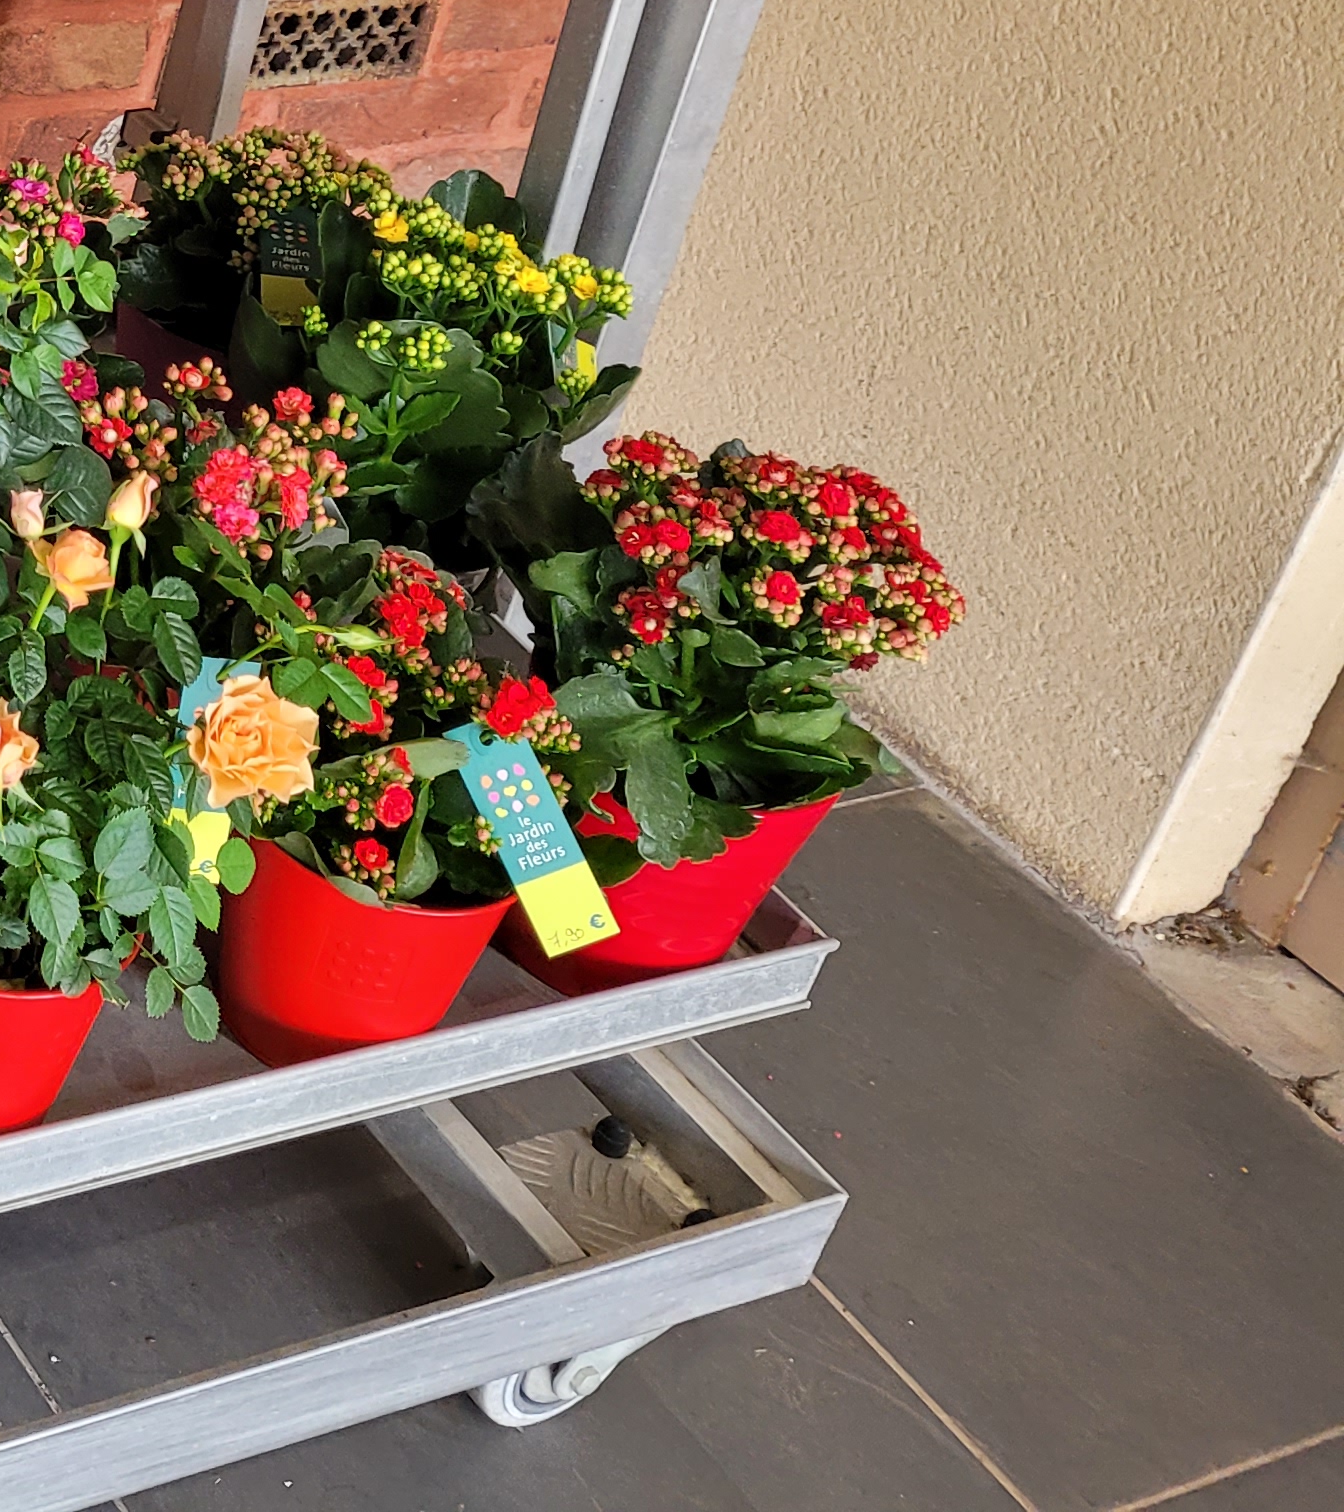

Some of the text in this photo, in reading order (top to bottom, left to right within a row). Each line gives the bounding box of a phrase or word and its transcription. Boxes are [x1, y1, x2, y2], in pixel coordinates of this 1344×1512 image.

[271, 247, 311, 258] Jardin
[271, 260, 311, 272] Fleurs
[517, 816, 531, 828] le
[508, 820, 555, 847] Jardin
[526, 838, 549, 854] des
[517, 843, 566, 871] Fleurs
[590, 913, 606, 929] €
